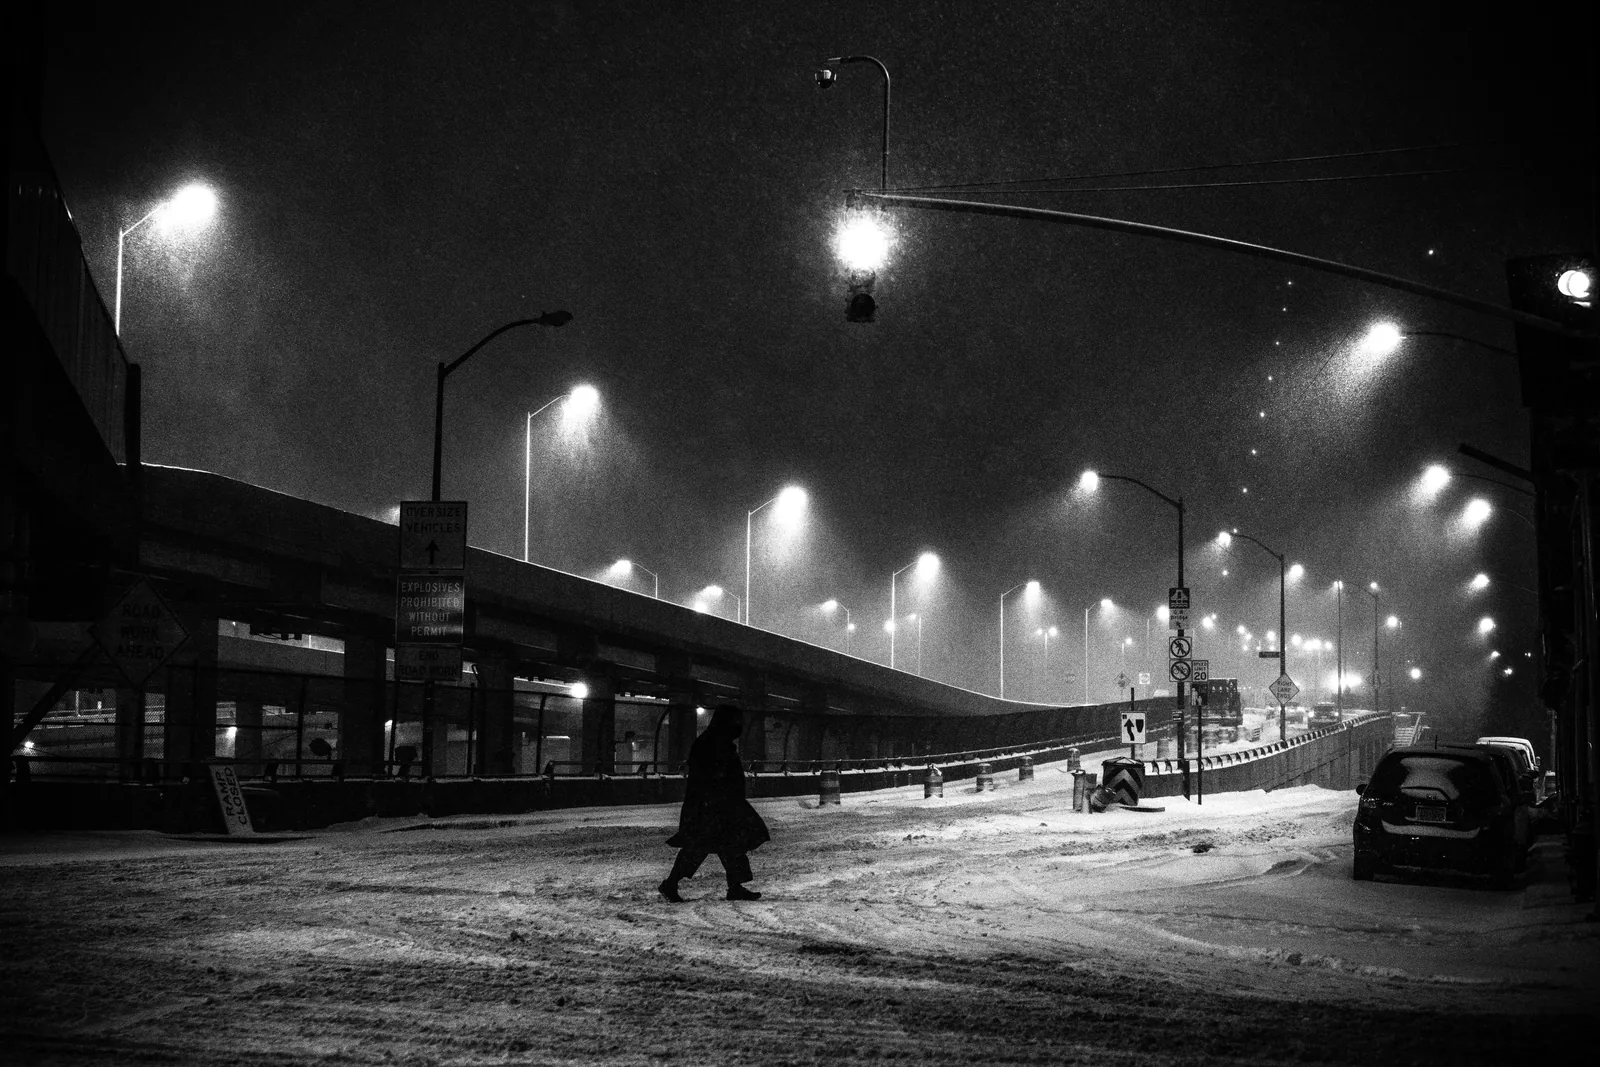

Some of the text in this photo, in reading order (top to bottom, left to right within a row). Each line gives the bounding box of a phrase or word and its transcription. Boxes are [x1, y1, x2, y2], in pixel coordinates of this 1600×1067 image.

[406, 507, 462, 518] OVERSIZE
[406, 523, 461, 534] VEHICLES
[401, 582, 461, 593] EXPLOSIVES
[401, 597, 460, 608] PROHIBITED
[408, 611, 451, 622] WITHOUT
[411, 626, 448, 637] PERMIT
[419, 650, 439, 661] END
[1194, 672, 1207, 681] 20
[215, 771, 235, 816] RAMP
[224, 767, 247, 825] CLOSED
